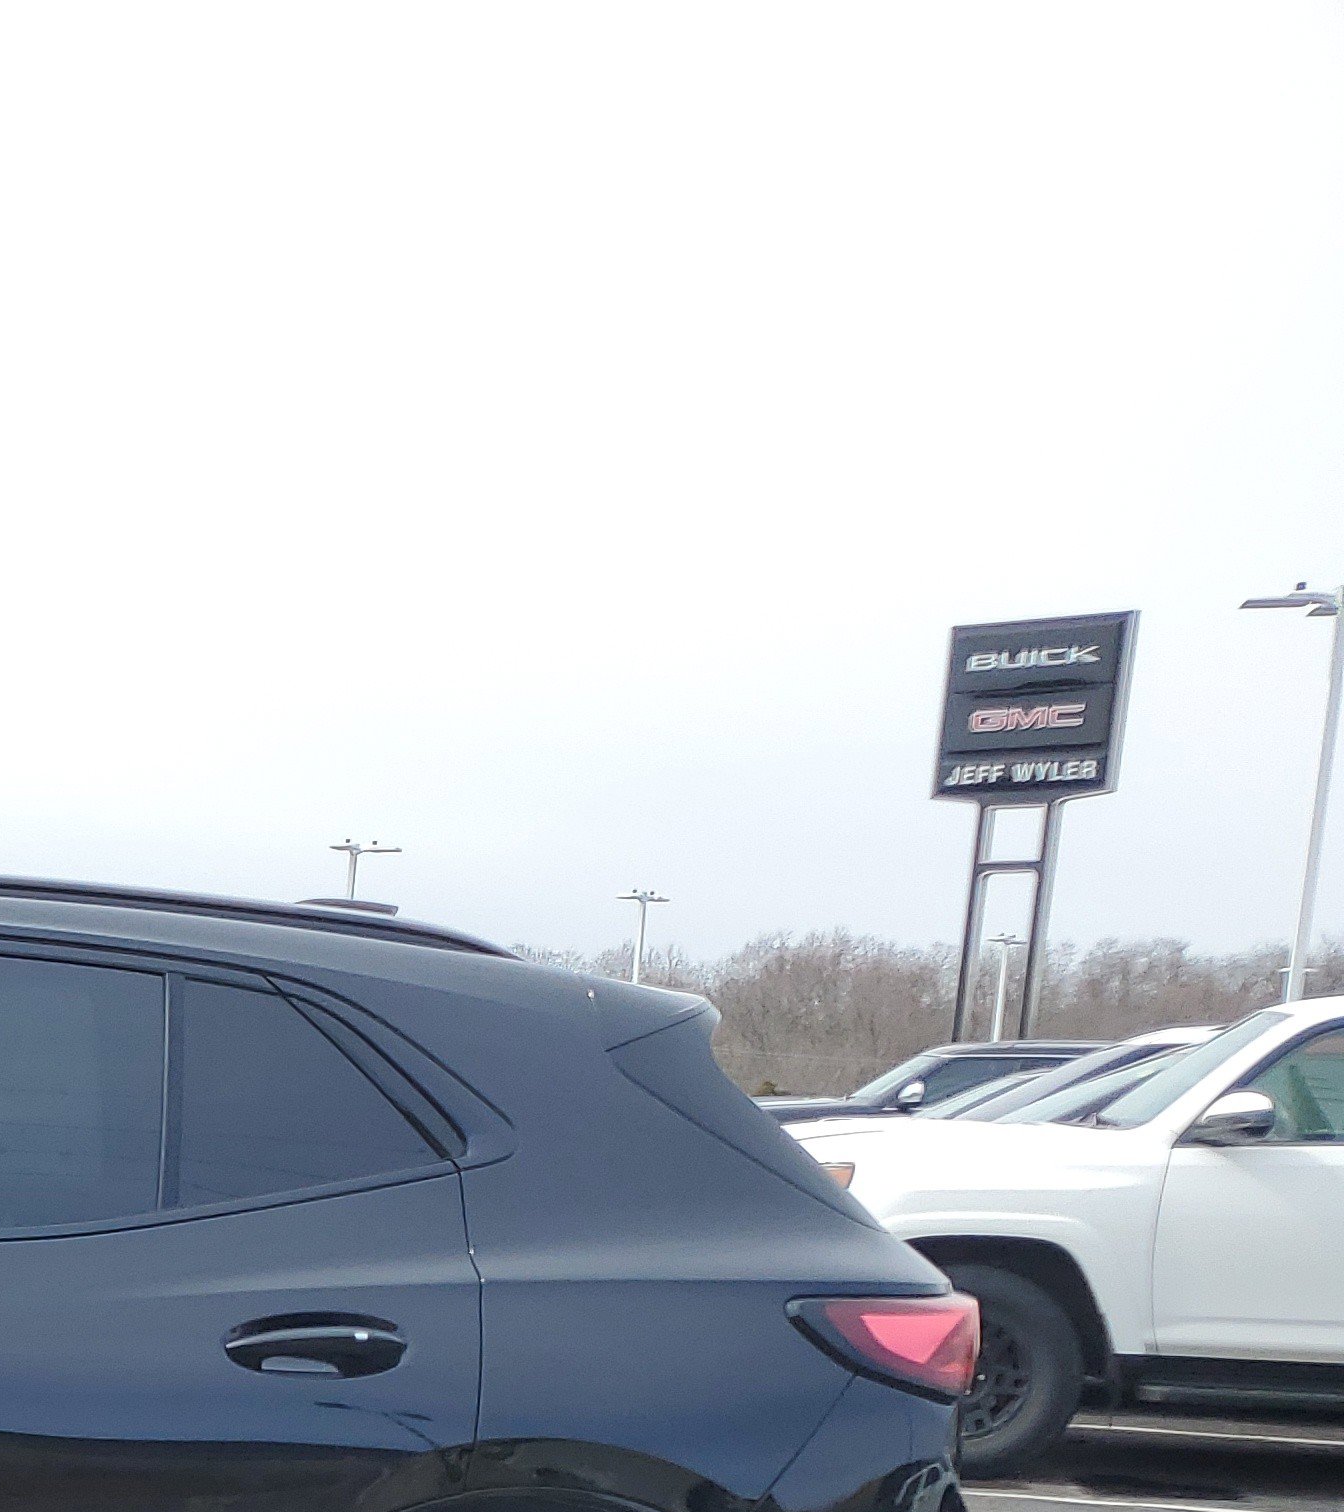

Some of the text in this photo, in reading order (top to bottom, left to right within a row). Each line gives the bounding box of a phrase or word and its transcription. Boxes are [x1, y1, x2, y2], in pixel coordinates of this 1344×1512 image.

[965, 645, 1101, 672] BUICK
[968, 701, 1088, 733] GMC
[943, 759, 1099, 786] JEFF WYLER
